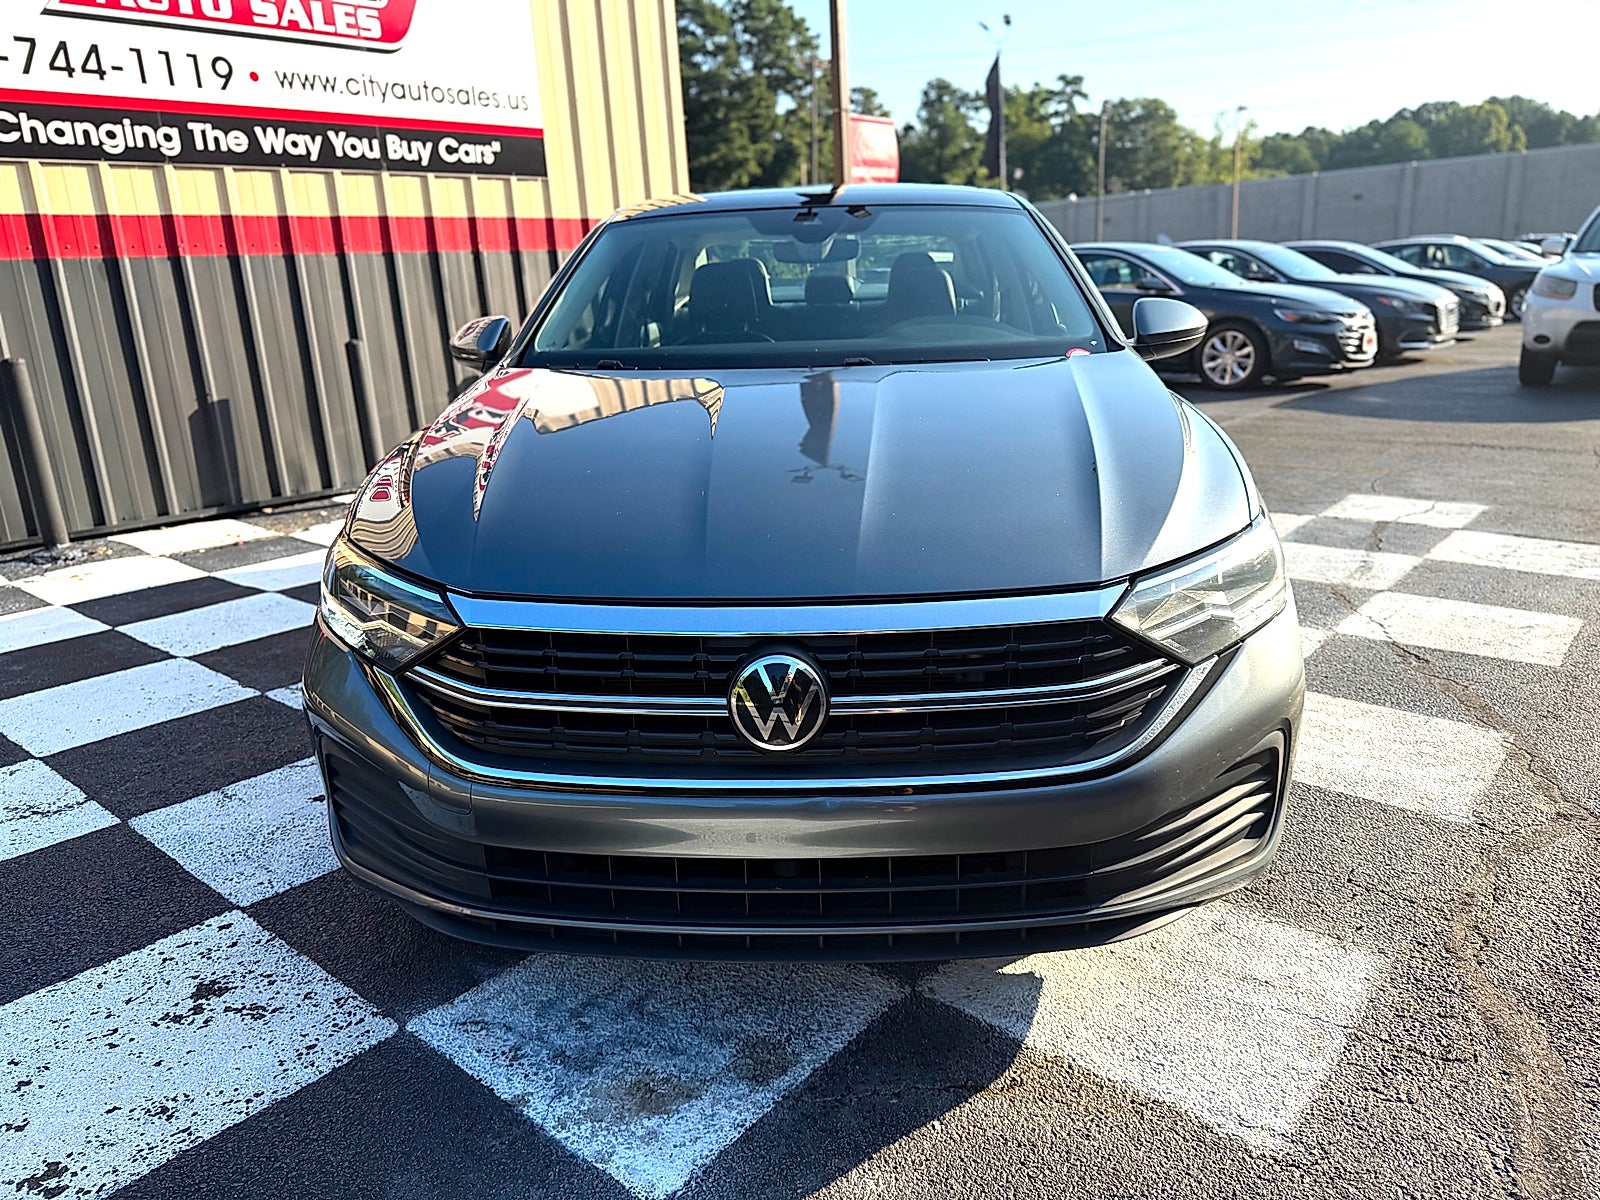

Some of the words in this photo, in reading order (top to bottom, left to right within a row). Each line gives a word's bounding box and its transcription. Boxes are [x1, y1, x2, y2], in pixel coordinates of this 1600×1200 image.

[250, 0, 383, 39] SALES
[275, 70, 529, 111] www.cityautosales.us
[0, 110, 182, 157] Changing
[187, 122, 250, 153] The
[253, 126, 323, 161] Way
[326, 130, 381, 159] You
[385, 134, 433, 167] Buy
[438, 137, 502, 165] Cars"
